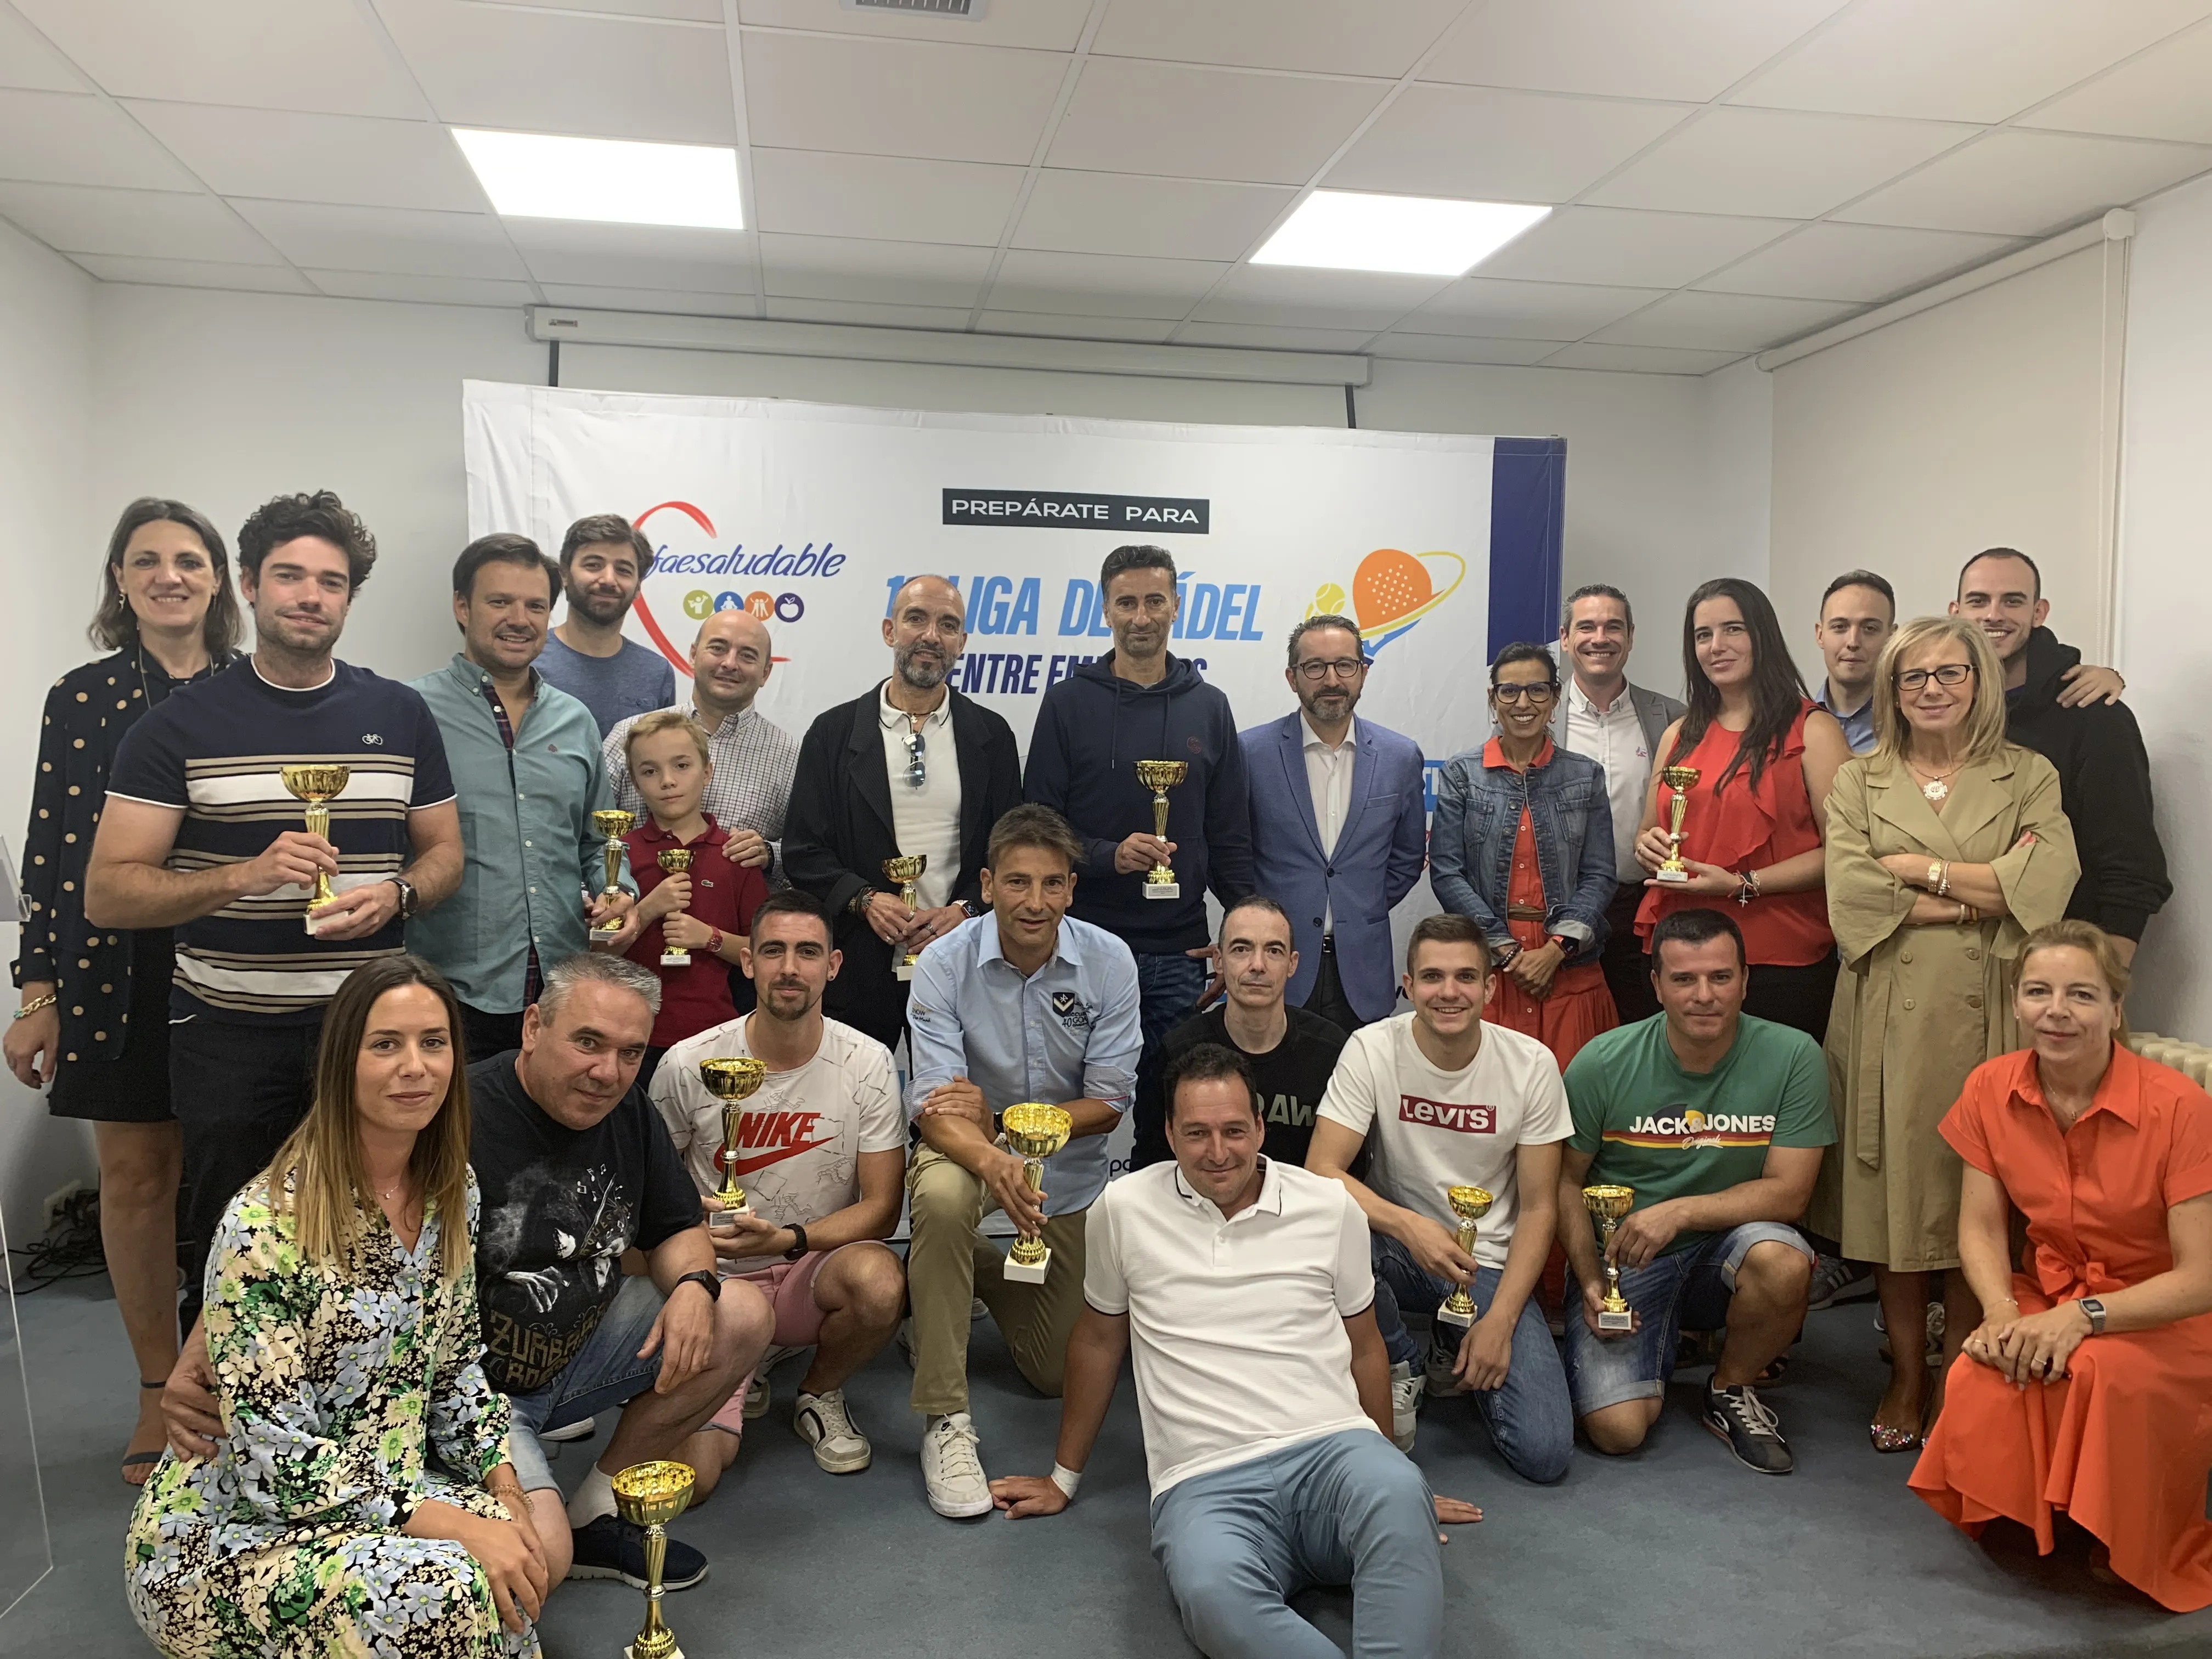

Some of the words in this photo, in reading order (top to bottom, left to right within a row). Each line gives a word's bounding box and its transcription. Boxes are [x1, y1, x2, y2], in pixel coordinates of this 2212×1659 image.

[952, 498, 1109, 520] PREPÁRATE
[1125, 506, 1199, 524] PARA
[642, 542, 846, 580] faesaludable
[949, 575, 1041, 635] IGA
[1172, 571, 1263, 641] ÁDEL
[735, 1111, 821, 1148] NIKE
